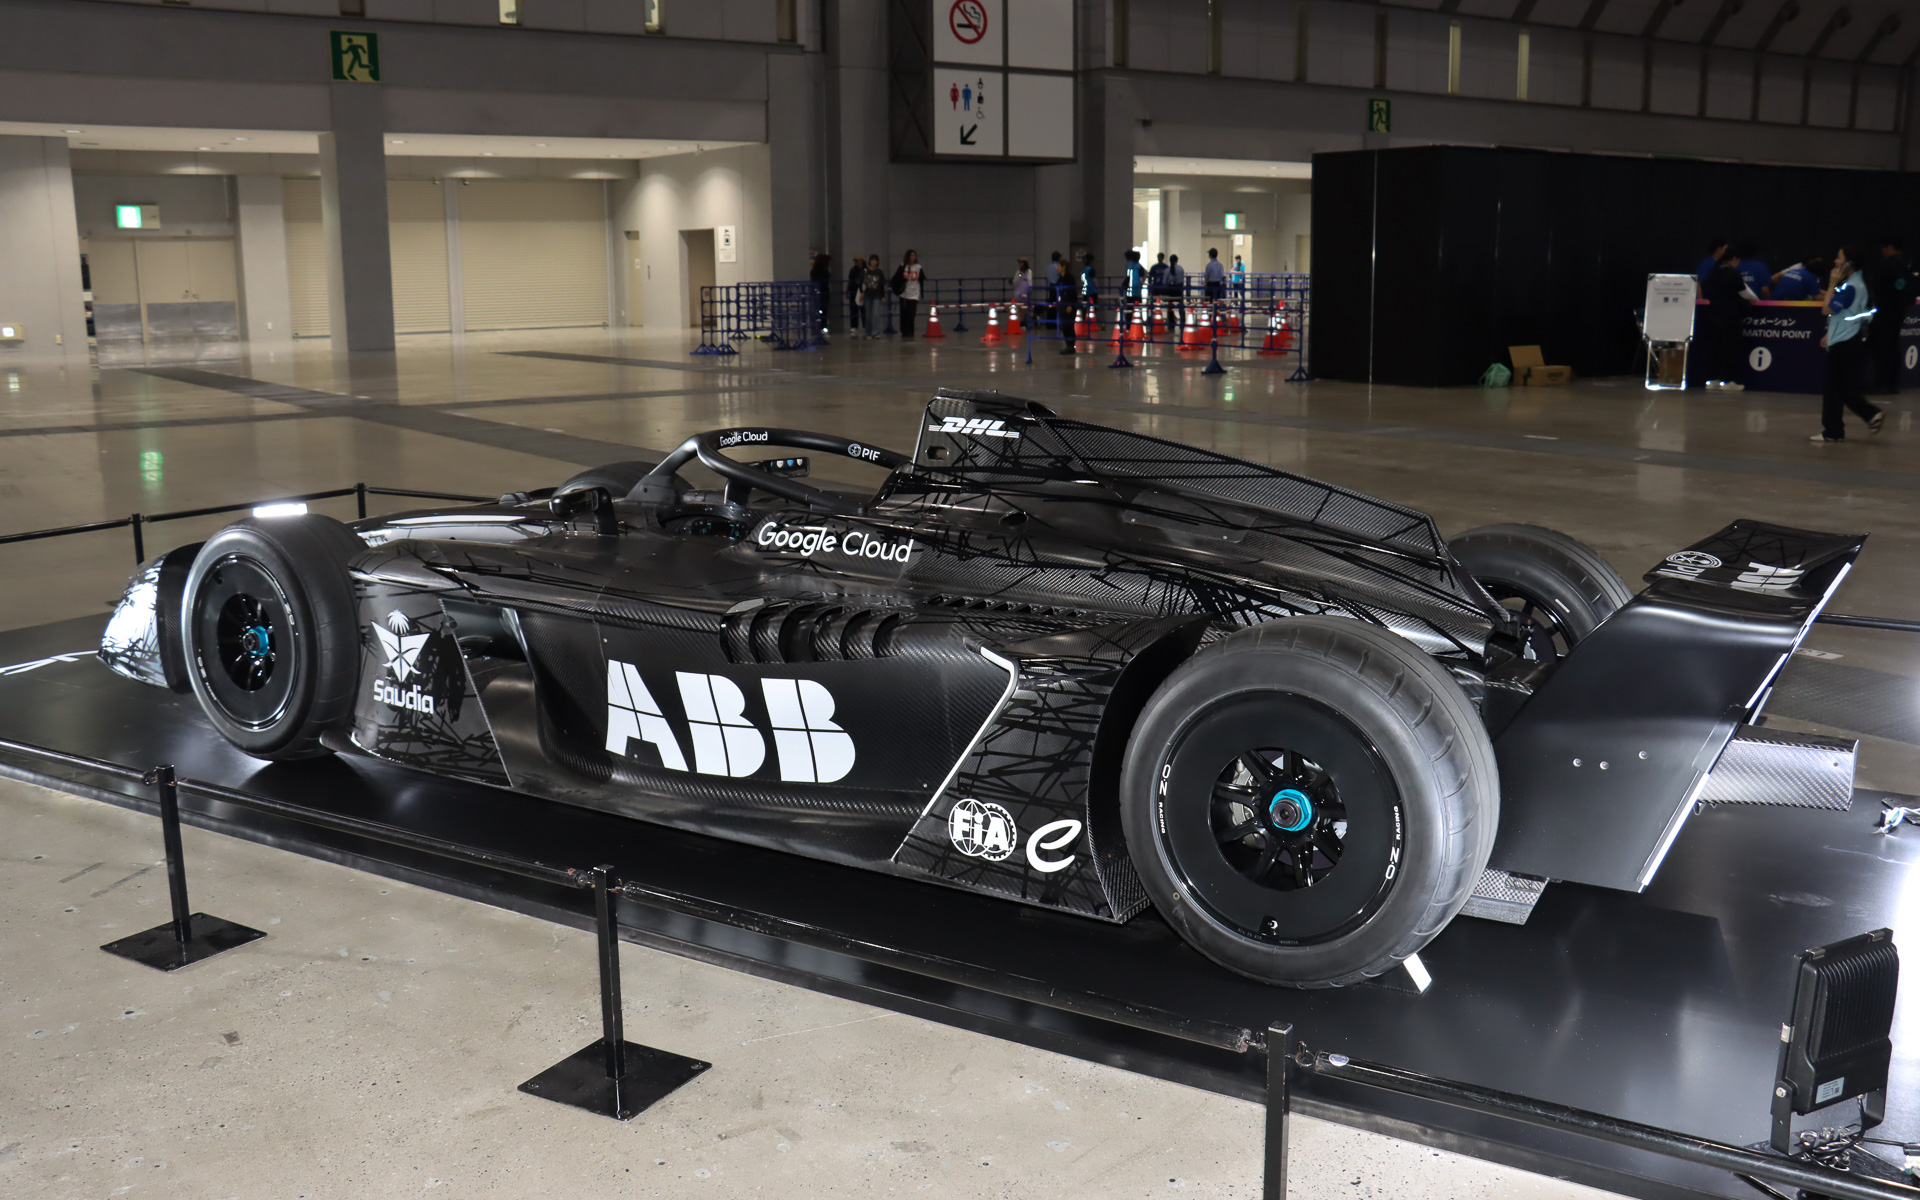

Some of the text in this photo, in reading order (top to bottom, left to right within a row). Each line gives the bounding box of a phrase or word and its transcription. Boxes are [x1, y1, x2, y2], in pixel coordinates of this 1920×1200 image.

[1782, 330, 1812, 339] POINT
[720, 431, 768, 446] Google Cloud
[939, 416, 1008, 437] DHL
[862, 448, 881, 460] PIF
[758, 521, 915, 562] Google Cloud
[373, 679, 434, 714] Saudia
[605, 659, 856, 783] ABB
[1158, 801, 1166, 834] RACING
[1393, 806, 1401, 840] RACING
